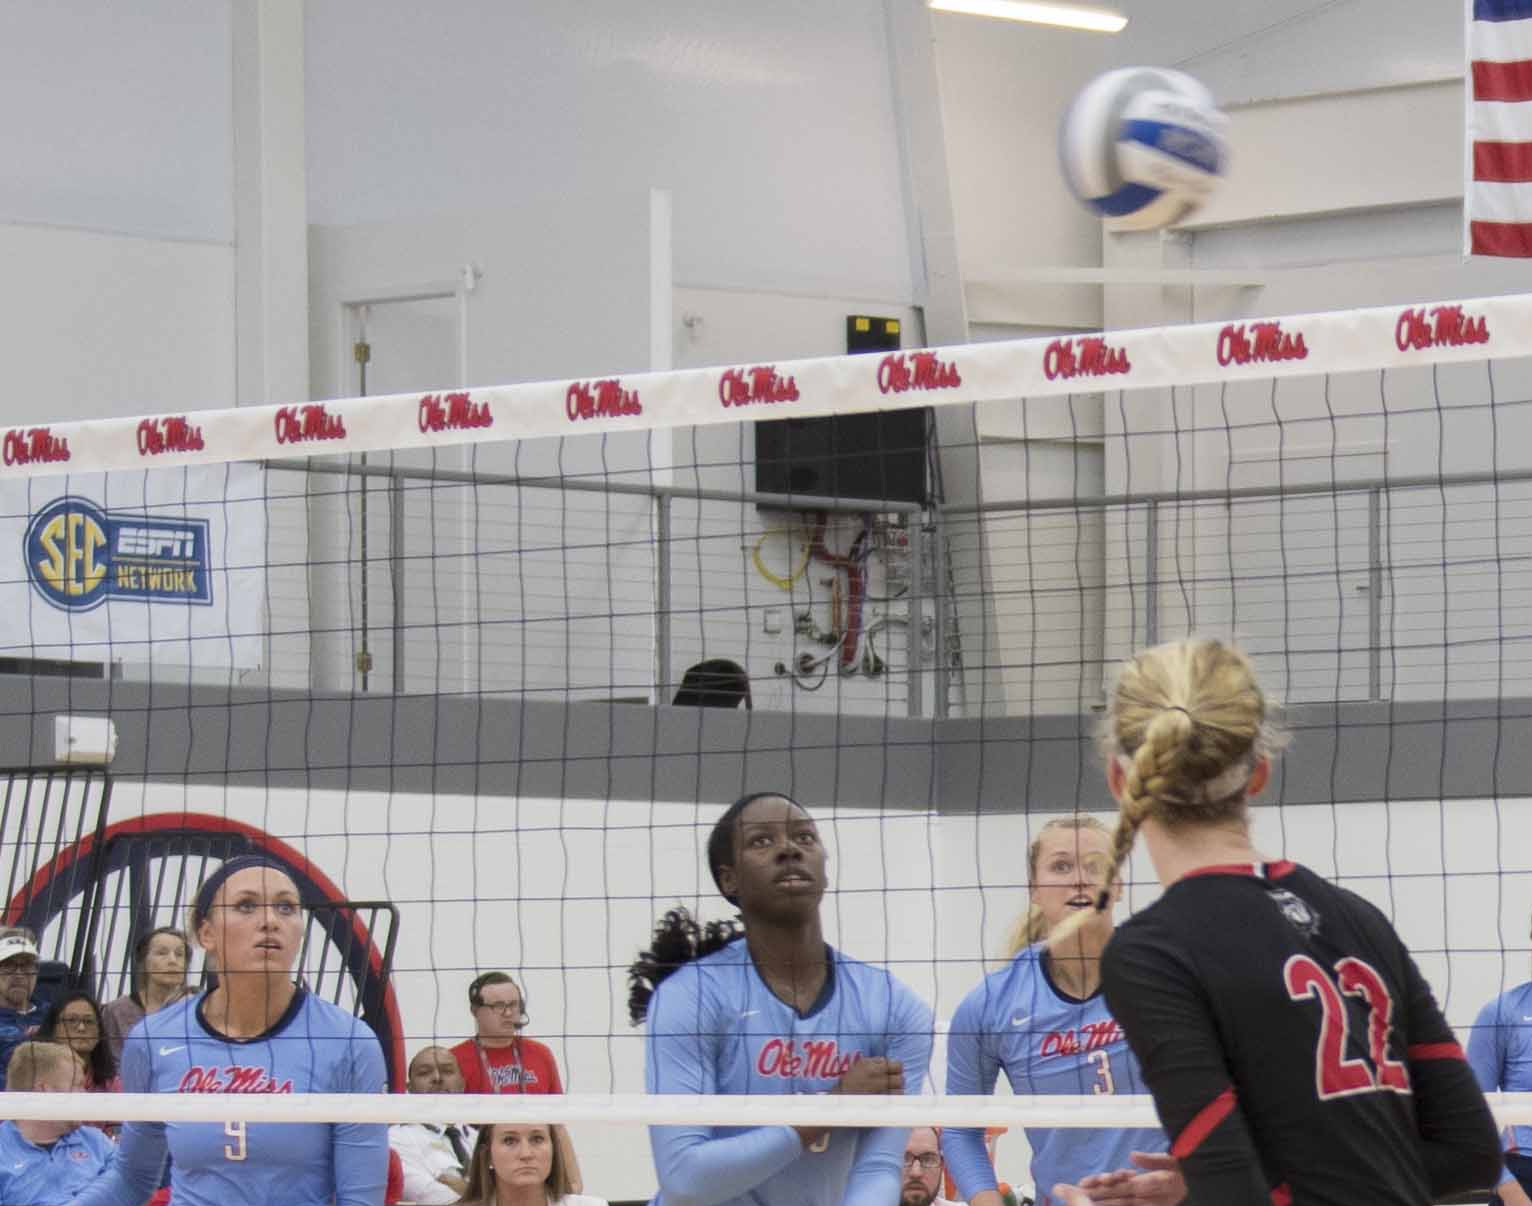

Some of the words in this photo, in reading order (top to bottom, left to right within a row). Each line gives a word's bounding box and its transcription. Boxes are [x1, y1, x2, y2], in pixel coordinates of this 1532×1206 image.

[1216, 325, 1251, 367] Ole
[1250, 323, 1309, 362] Miss
[1395, 308, 1432, 353] Ole
[1431, 306, 1489, 348] Miss
[877, 355, 911, 394] Ole
[908, 351, 961, 390] Miss
[1042, 340, 1077, 380] Ole
[1076, 337, 1131, 377] Miss
[565, 383, 595, 421] Ole
[593, 380, 642, 417] Miss
[719, 369, 751, 407] Ole
[748, 367, 800, 404] Miss
[274, 408, 303, 444] Ole
[301, 405, 346, 440] Miss
[420, 396, 446, 432] Ole
[444, 392, 493, 429] Miss
[3, 431, 29, 465] Ole
[28, 429, 70, 462] Miss
[139, 420, 163, 455] Ole
[162, 417, 204, 451] Miss
[40, 513, 106, 595] SEC
[118, 527, 194, 558] ESPN
[117, 564, 197, 593] NETWORK
[1040, 1028, 1081, 1057] Ole
[1283, 953, 1413, 1101] 22
[756, 1034, 802, 1079] Ole
[1087, 1050, 1115, 1096] 3
[178, 1065, 224, 1094] Ole
[223, 1065, 294, 1094] Miss
[224, 1120, 248, 1162] 9
